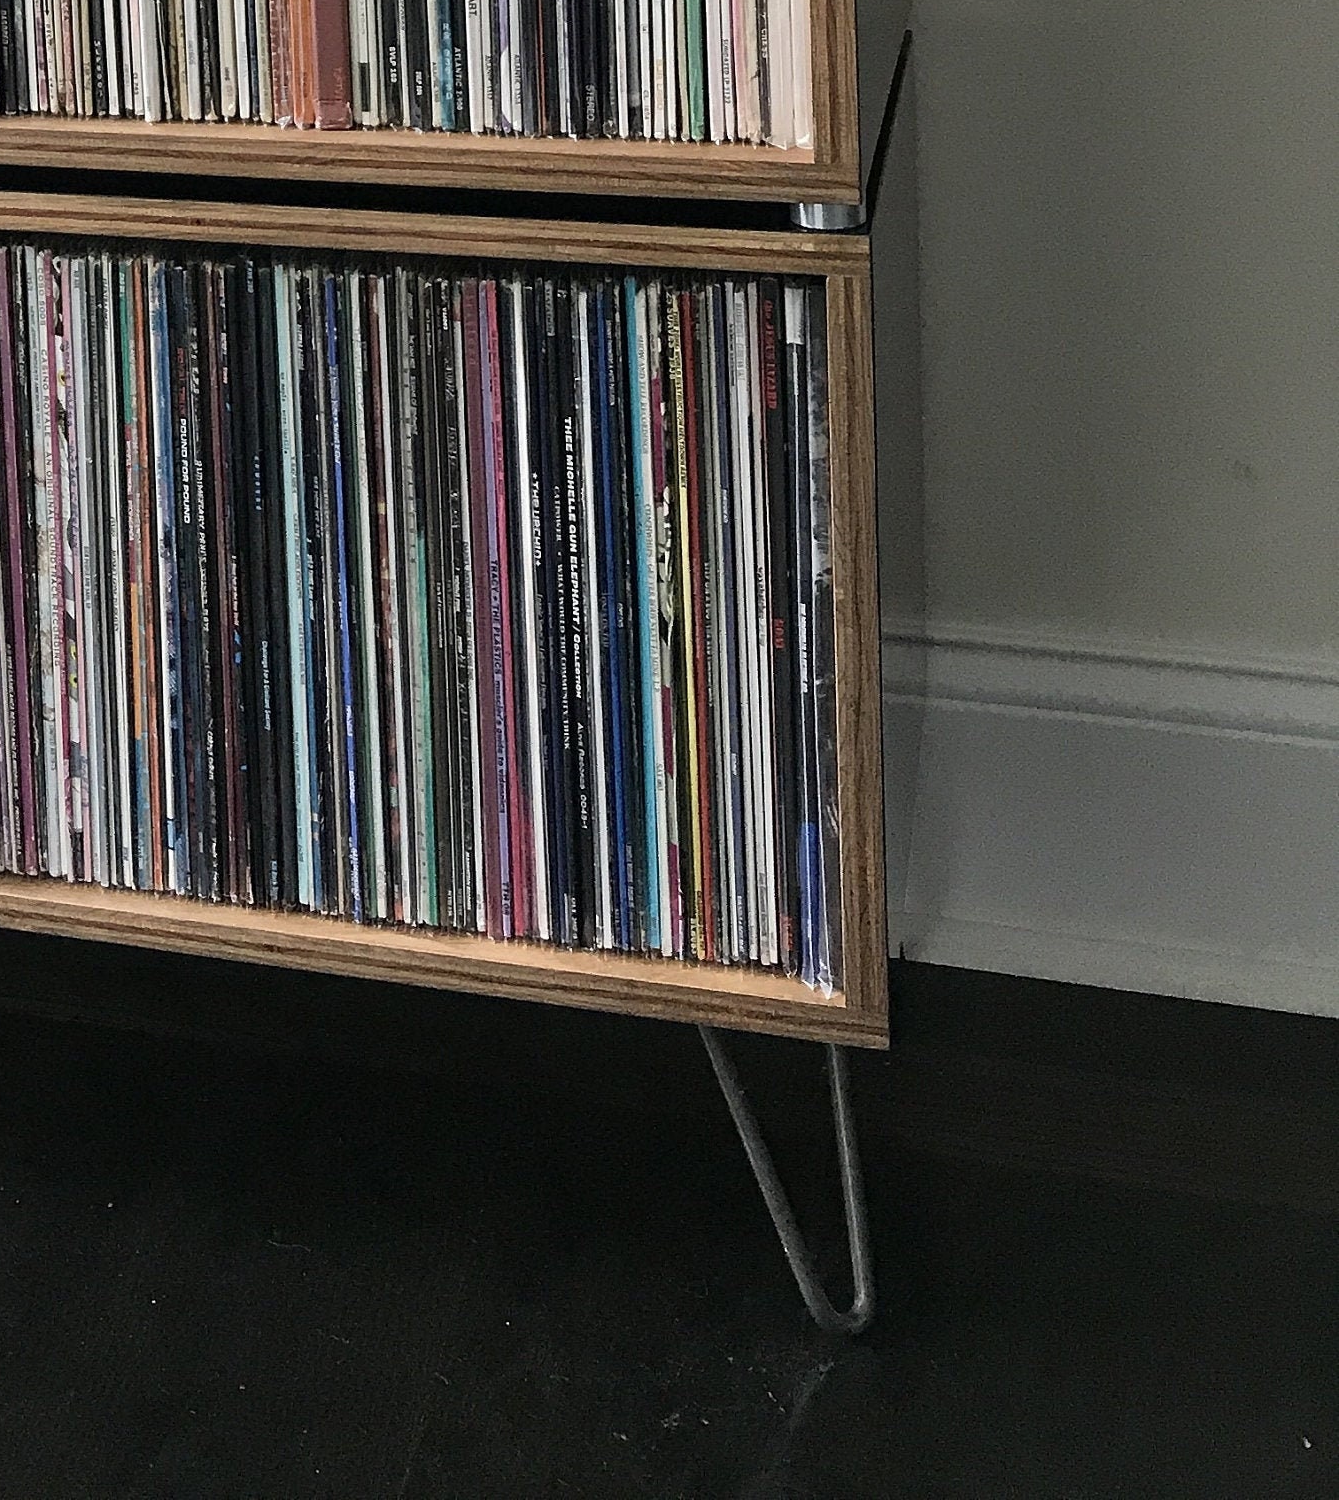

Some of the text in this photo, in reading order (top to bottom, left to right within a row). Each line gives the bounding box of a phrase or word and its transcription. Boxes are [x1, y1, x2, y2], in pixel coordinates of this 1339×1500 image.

[584, 85, 595, 121] STEREO
[179, 419, 190, 523] POUND FOR POUND
[563, 417, 581, 624] THEE MICHELLE GUN ELEPHANT
[489, 559, 498, 593] TRACY
[490, 605, 498, 623] THE
[491, 626, 501, 674] PLASTICS
[494, 727, 503, 754] guide
